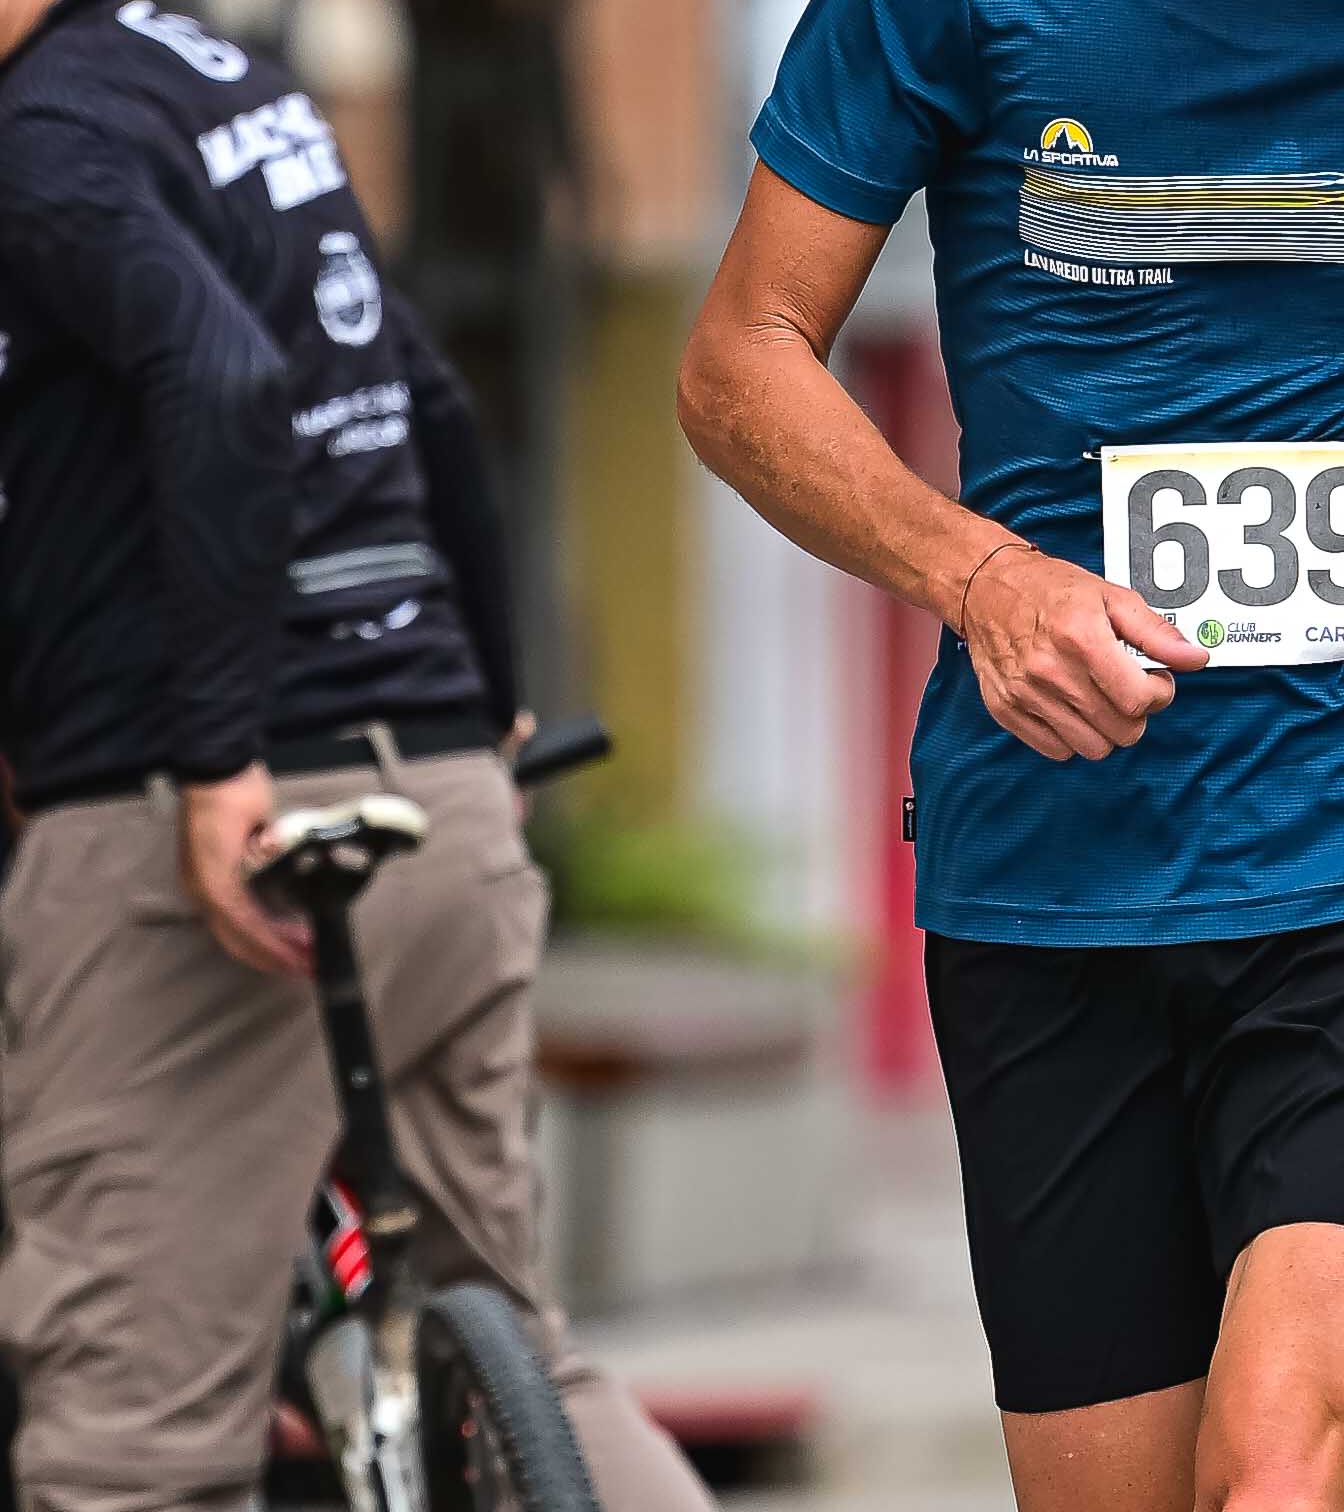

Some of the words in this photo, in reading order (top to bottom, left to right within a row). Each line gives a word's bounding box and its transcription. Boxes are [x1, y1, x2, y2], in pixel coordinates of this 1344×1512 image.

[1023, 147, 1039, 162] LA
[1041, 152, 1120, 167] SPORTIVA
[1024, 249, 1089, 283] LAVAREDO
[1091, 267, 1135, 286] ULTRA
[1137, 267, 1174, 285] TRAIL
[1227, 622, 1257, 633] CLUB
